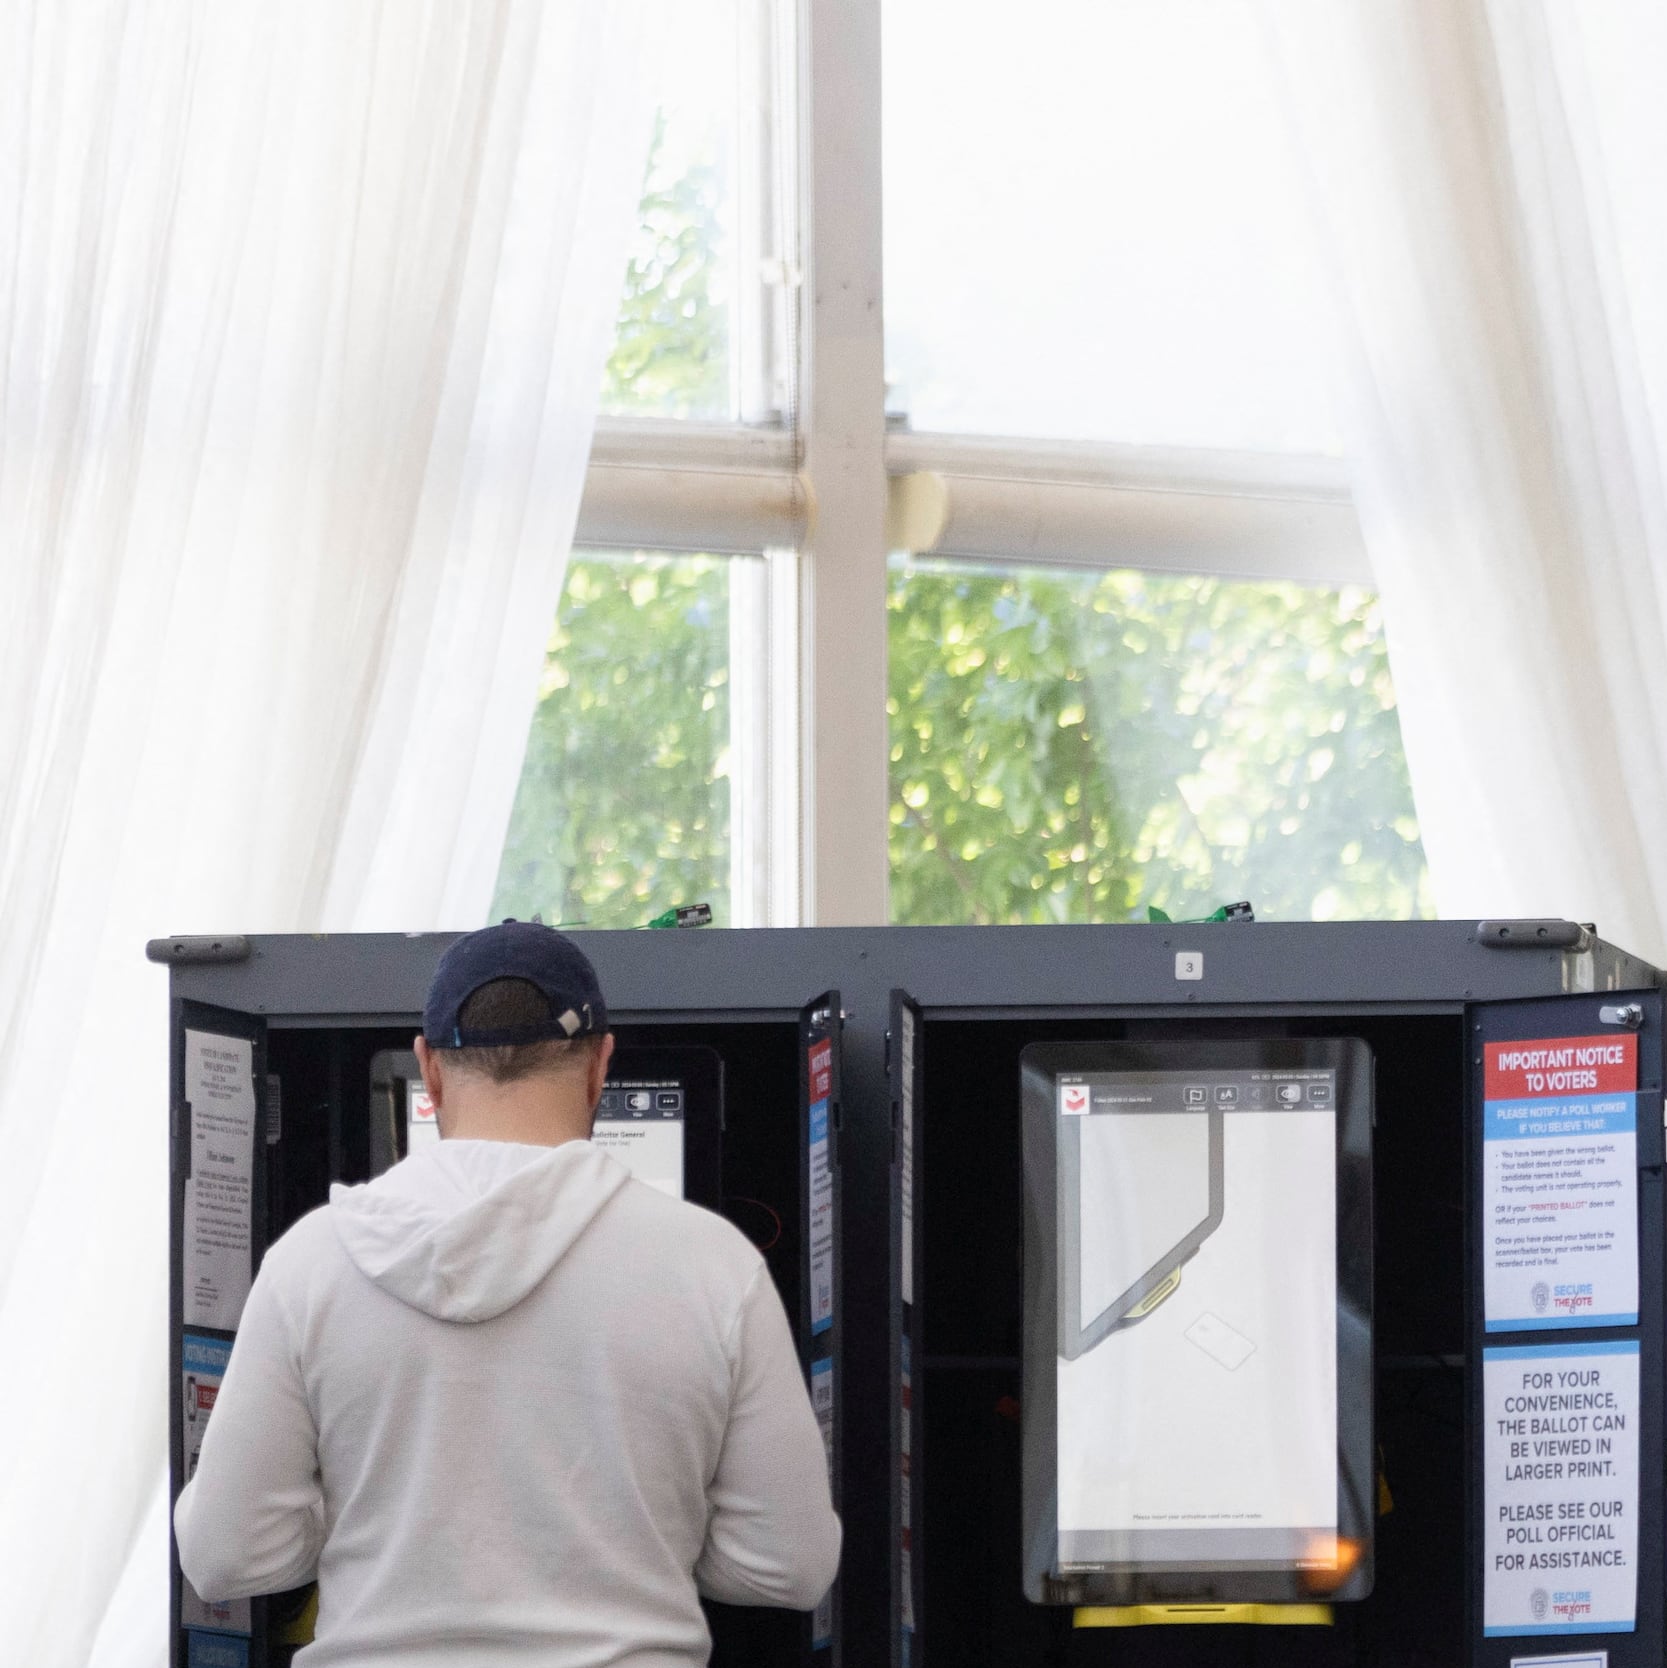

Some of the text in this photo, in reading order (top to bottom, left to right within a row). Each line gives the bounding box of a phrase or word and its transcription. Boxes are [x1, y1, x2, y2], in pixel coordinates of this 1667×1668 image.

[1186, 962, 1194, 973] 3
[1498, 1046, 1623, 1071] IMPORTANT NOTICE
[1526, 1070, 1597, 1091] TO VOTERS
[1523, 1370, 1600, 1389] FOR YOUR
[1505, 1394, 1618, 1414] CONVENIENCE,
[1498, 1415, 1625, 1435] THE BALLOT CAN
[1510, 1438, 1611, 1458] BE VIEWED IN
[1506, 1460, 1616, 1481] LARGER PRINT.
[1500, 1501, 1622, 1522] PLEASE SEE OUR
[1507, 1524, 1614, 1544] POLL OFFICIAL
[1496, 1550, 1626, 1570] FOR ASSISTANCE.
